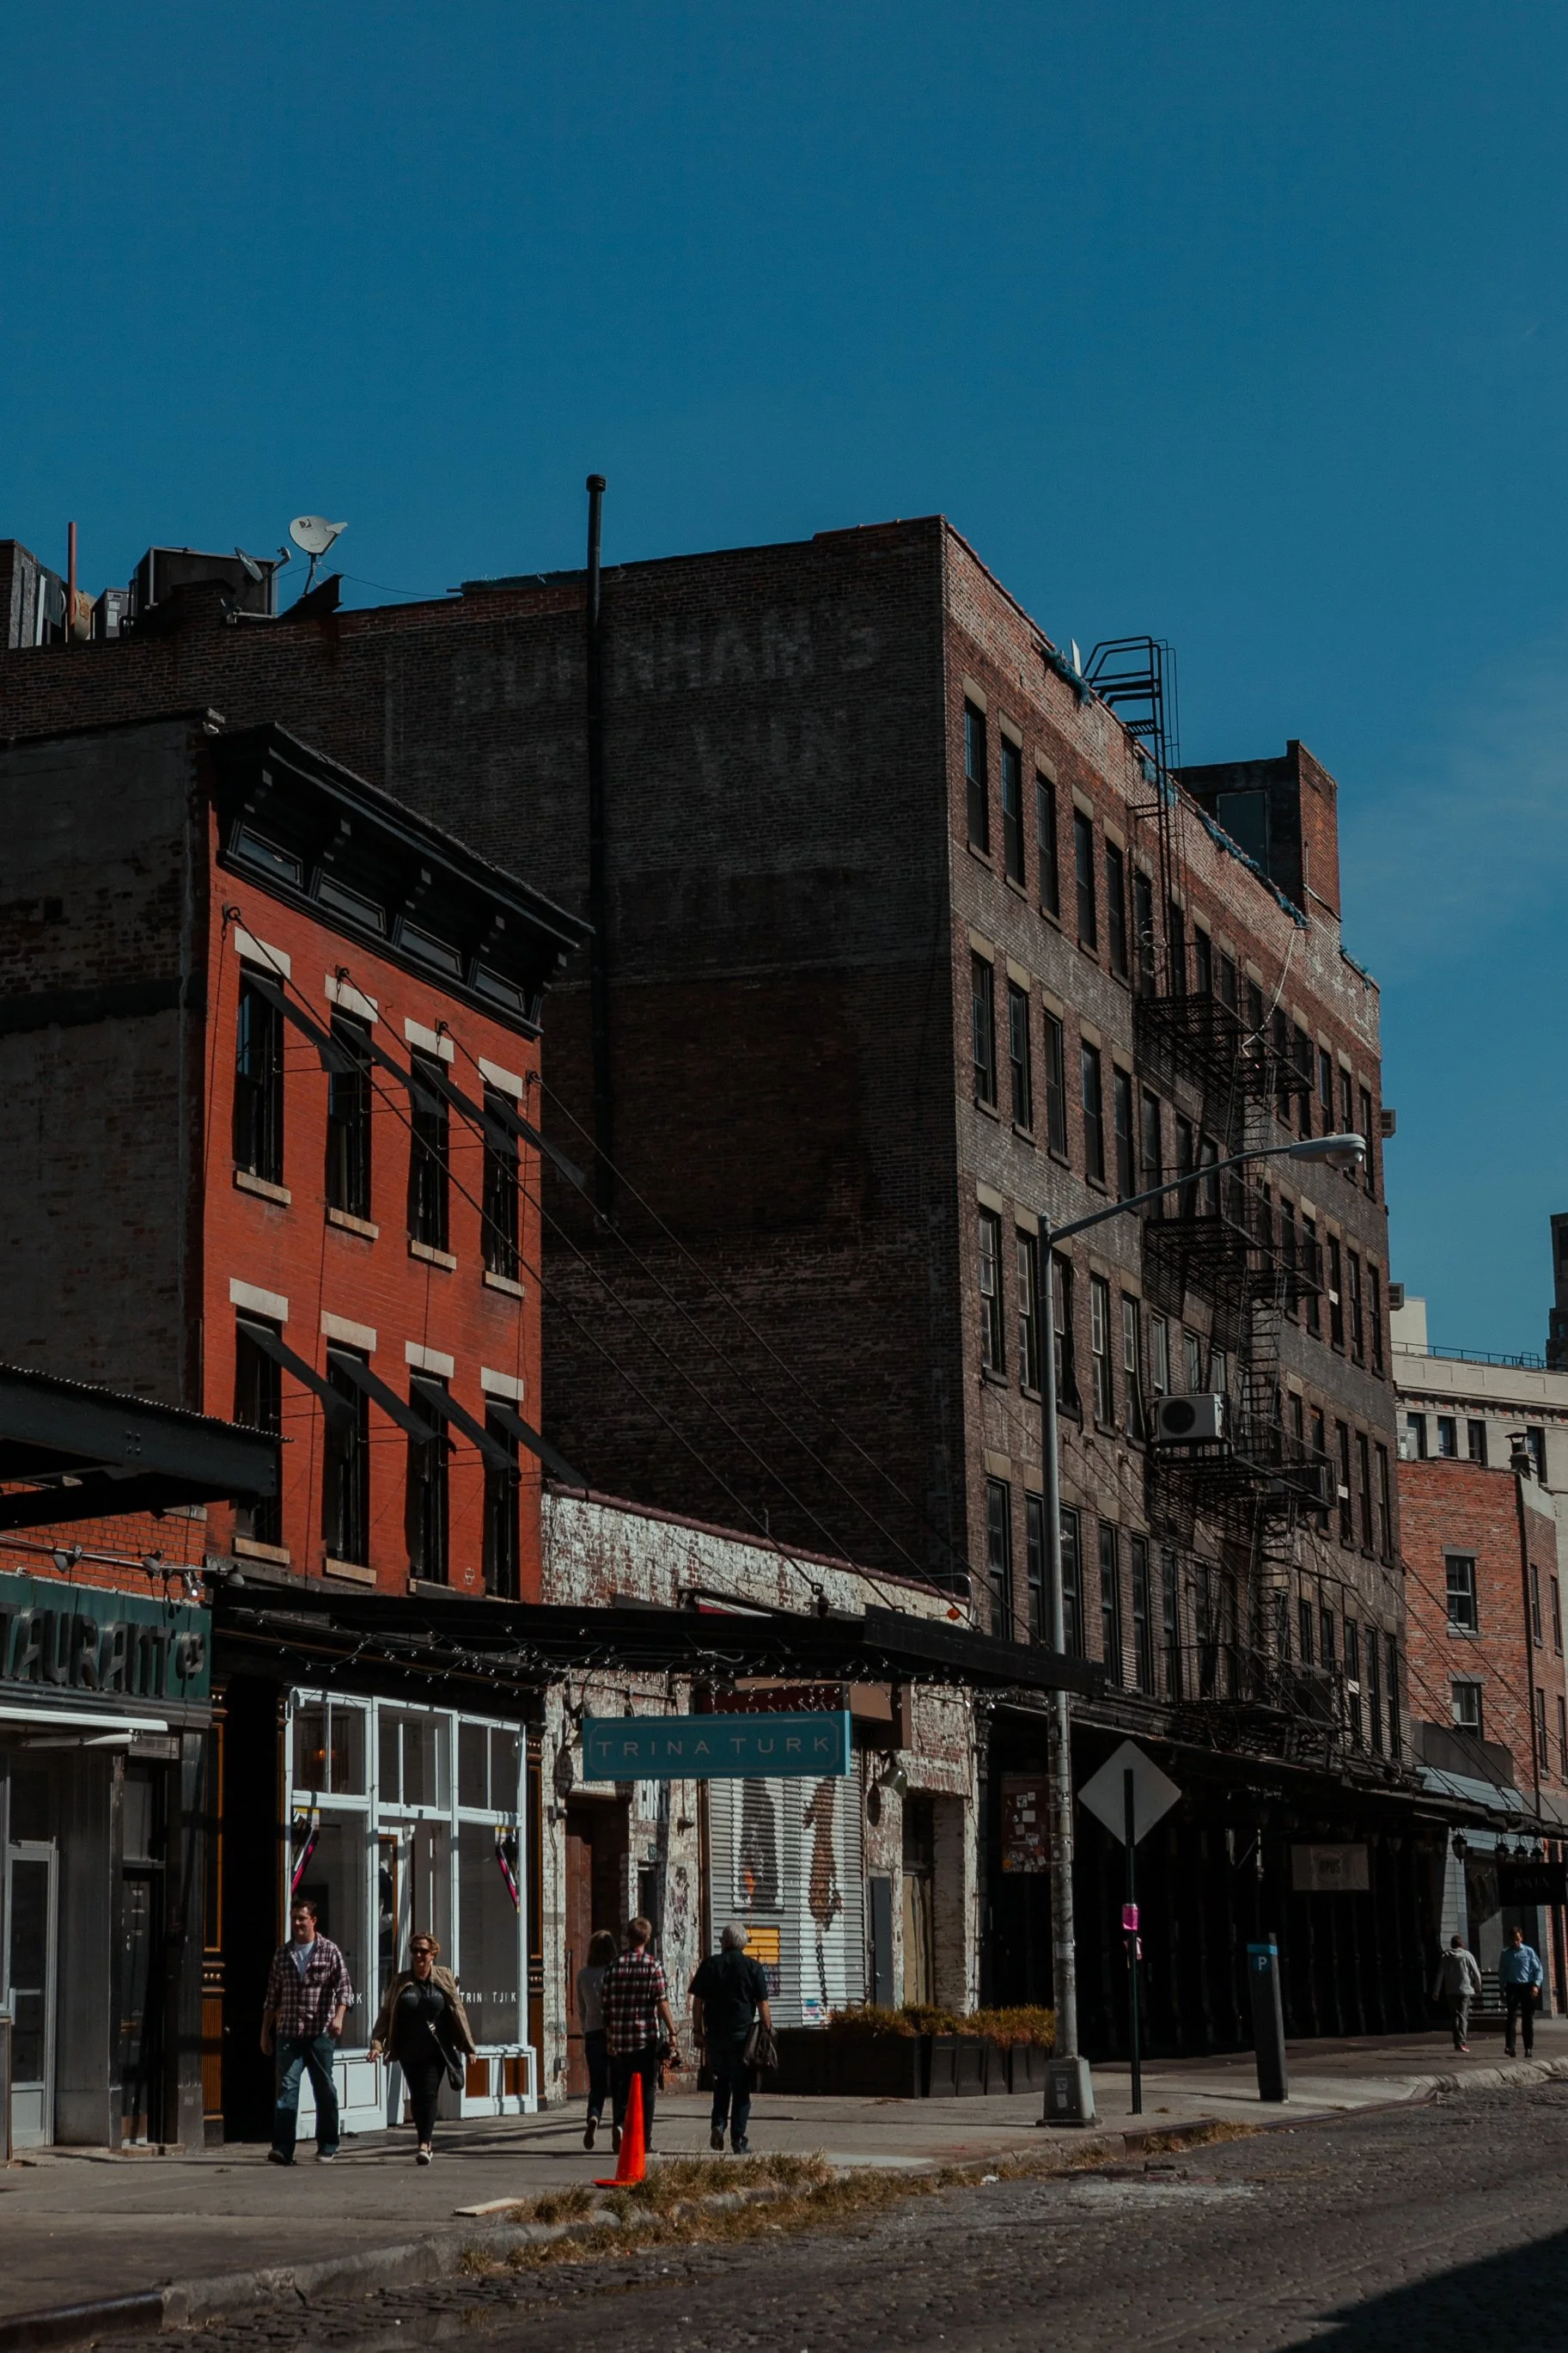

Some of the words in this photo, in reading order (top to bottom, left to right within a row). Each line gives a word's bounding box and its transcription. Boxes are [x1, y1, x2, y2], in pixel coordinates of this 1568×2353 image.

[596, 1739, 711, 1757] TRINA
[730, 1736, 830, 1755] TURK
[1258, 1956, 1267, 1971] P
[460, 1991, 488, 2003] TRIN
